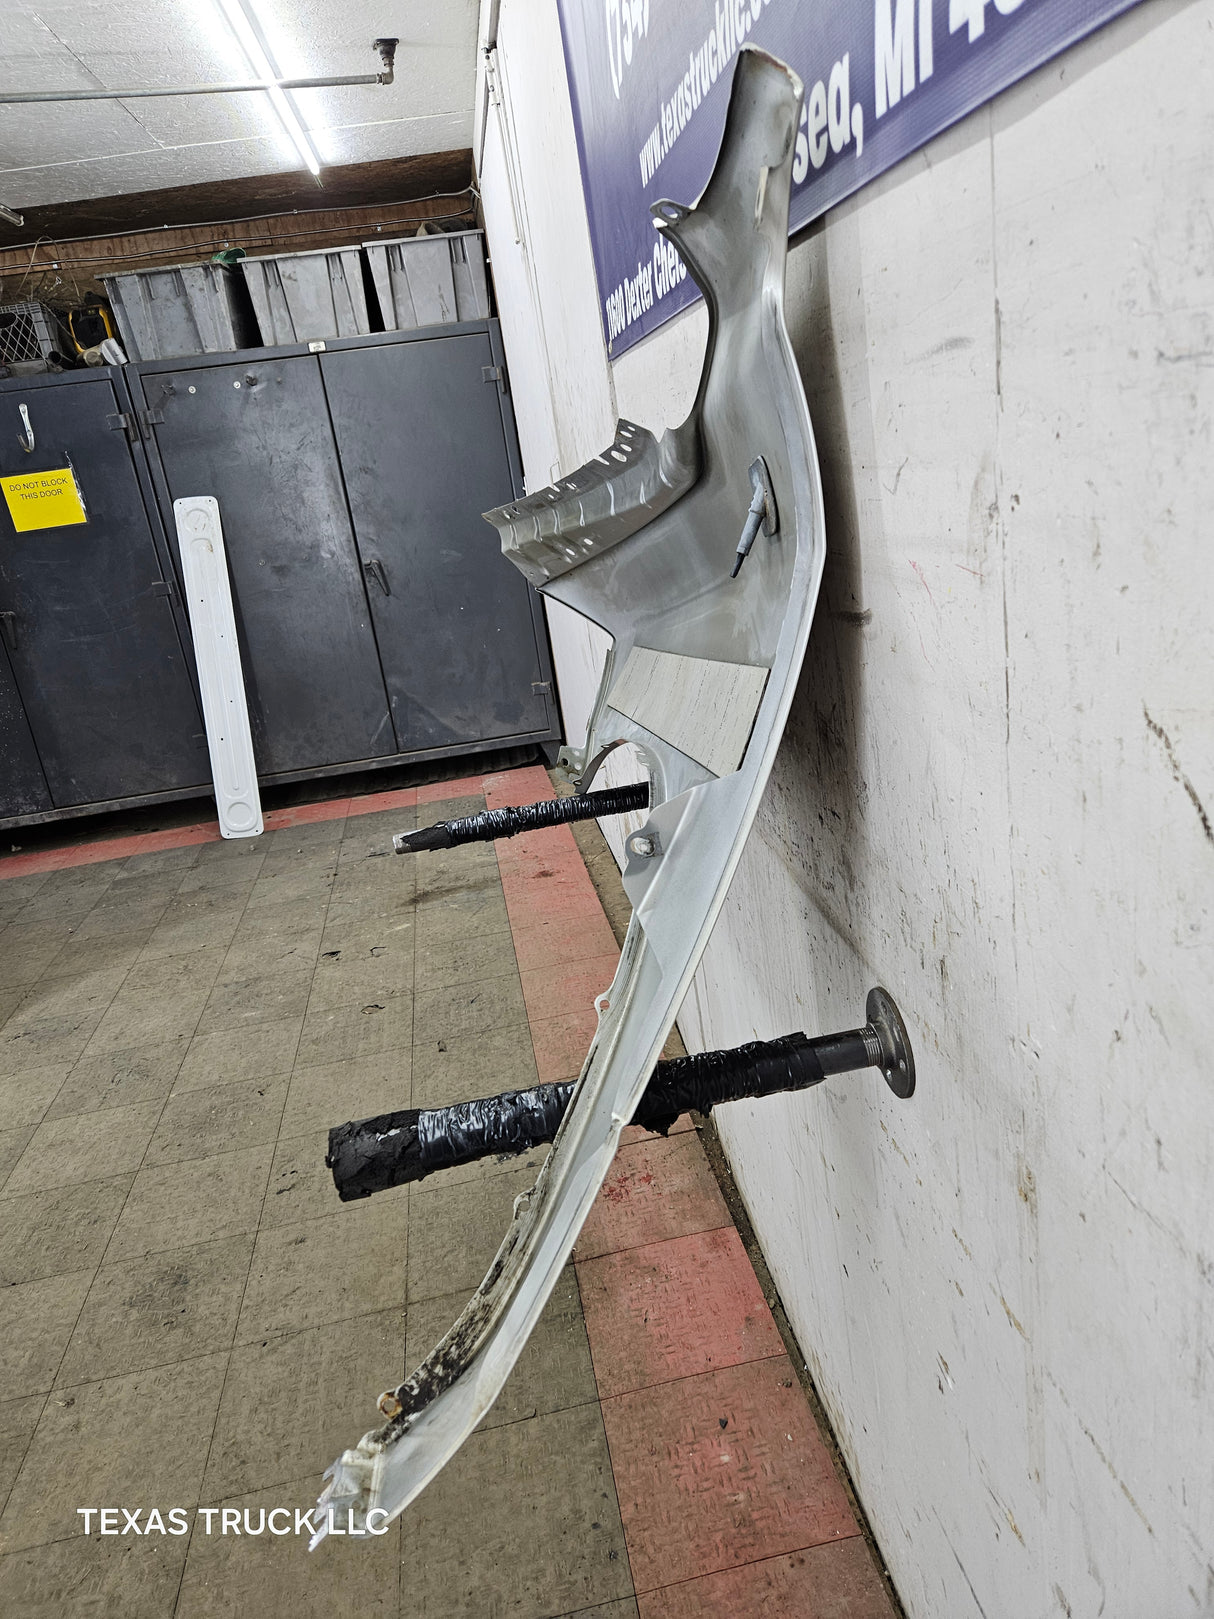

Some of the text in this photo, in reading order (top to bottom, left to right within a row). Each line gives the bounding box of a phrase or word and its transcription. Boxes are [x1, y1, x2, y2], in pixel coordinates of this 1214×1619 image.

[639, 0, 770, 188] www.texastruckllc.
[624, 260, 654, 326] Dexter
[792, 51, 864, 184] sea,
[9, 477, 68, 492] DO NOT BLOCK
[20, 488, 63, 500] THIS DOOR
